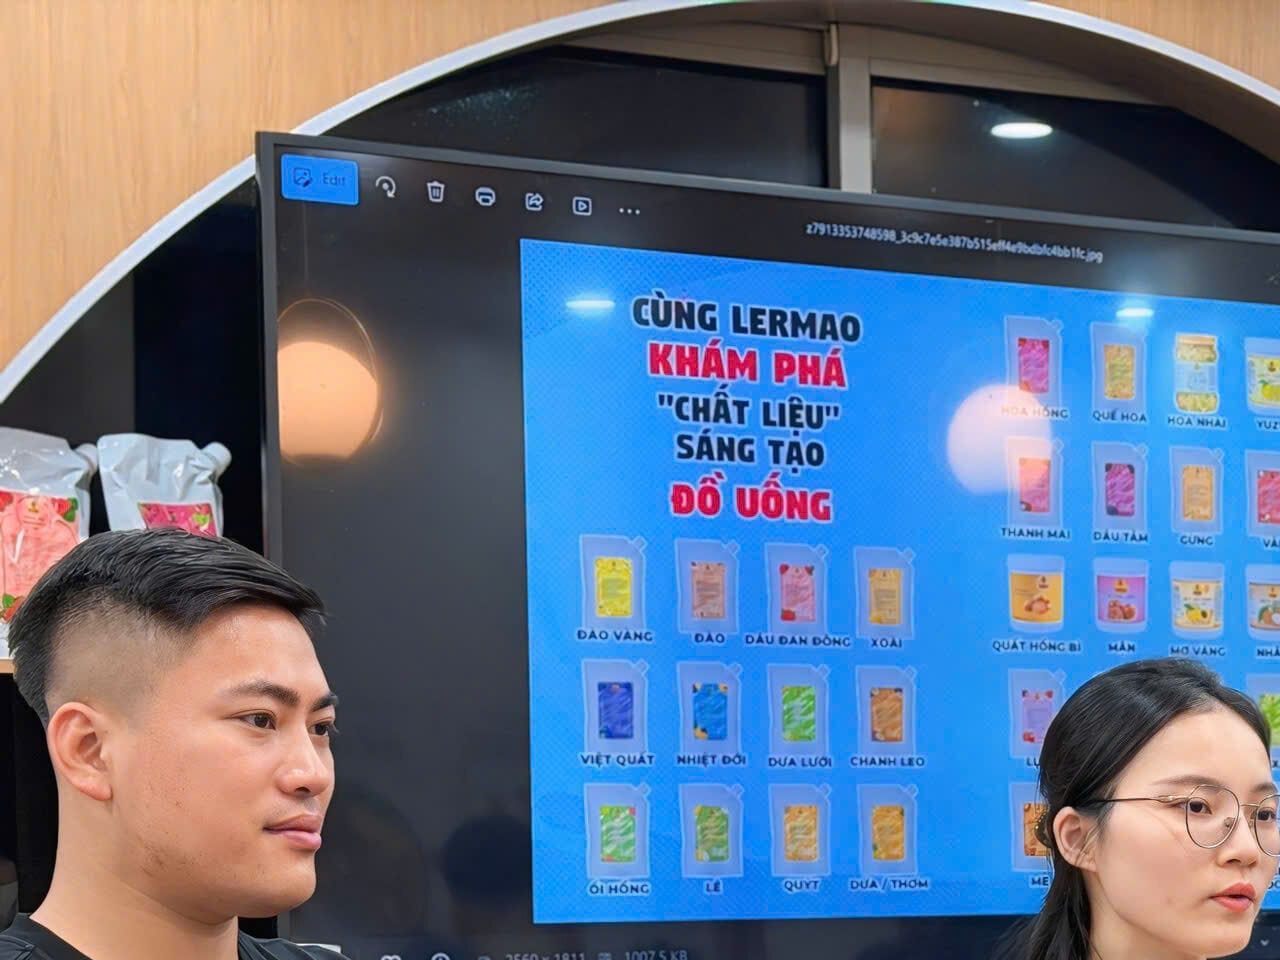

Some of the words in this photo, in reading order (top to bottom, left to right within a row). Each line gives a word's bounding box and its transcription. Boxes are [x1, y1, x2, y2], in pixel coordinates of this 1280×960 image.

[322, 172, 346, 187] Edit
[633, 290, 717, 331] CÙNG
[732, 305, 861, 342] LERMAO
[648, 339, 757, 382] KHÁM
[774, 348, 846, 388] PHÁ
[658, 384, 749, 425] "CHẤT
[762, 396, 839, 436] LIỆU"
[1121, 411, 1147, 422] HOA
[1168, 416, 1193, 426] HOA
[677, 428, 755, 463] SÁNG
[768, 439, 825, 474] TẠO
[671, 472, 724, 516] ĐỒ
[736, 472, 831, 520] UỐNG
[1001, 527, 1043, 538] THANH
[1047, 529, 1071, 540] MAI
[581, 752, 611, 768] VIỆT
[677, 753, 717, 768] NHIỆT
[849, 756, 896, 767] CHANH
[900, 757, 925, 768] LEO
